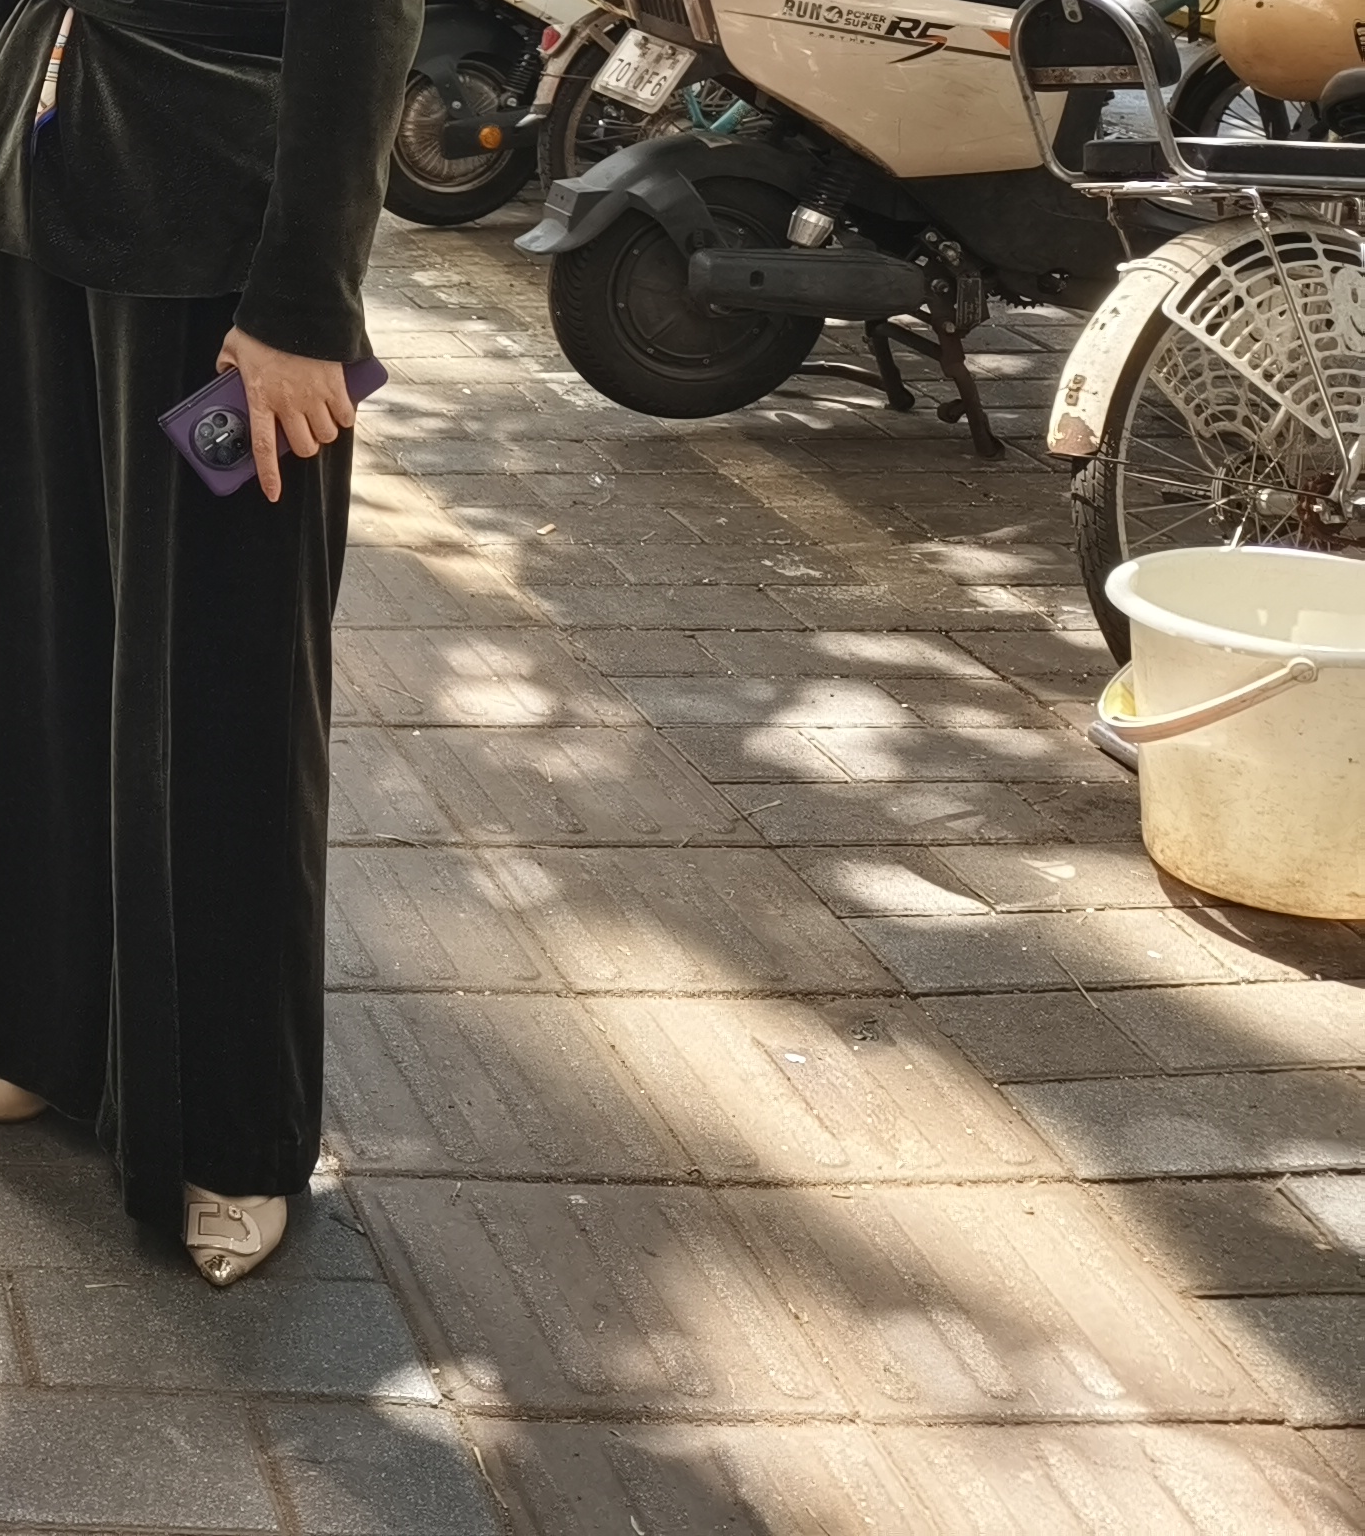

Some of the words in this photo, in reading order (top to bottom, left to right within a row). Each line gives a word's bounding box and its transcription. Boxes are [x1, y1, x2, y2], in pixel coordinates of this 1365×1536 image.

[782, 0, 821, 21] RUN
[846, 9, 886, 24] POWER
[844, 18, 882, 32] SUPER
[884, 15, 956, 64] R5
